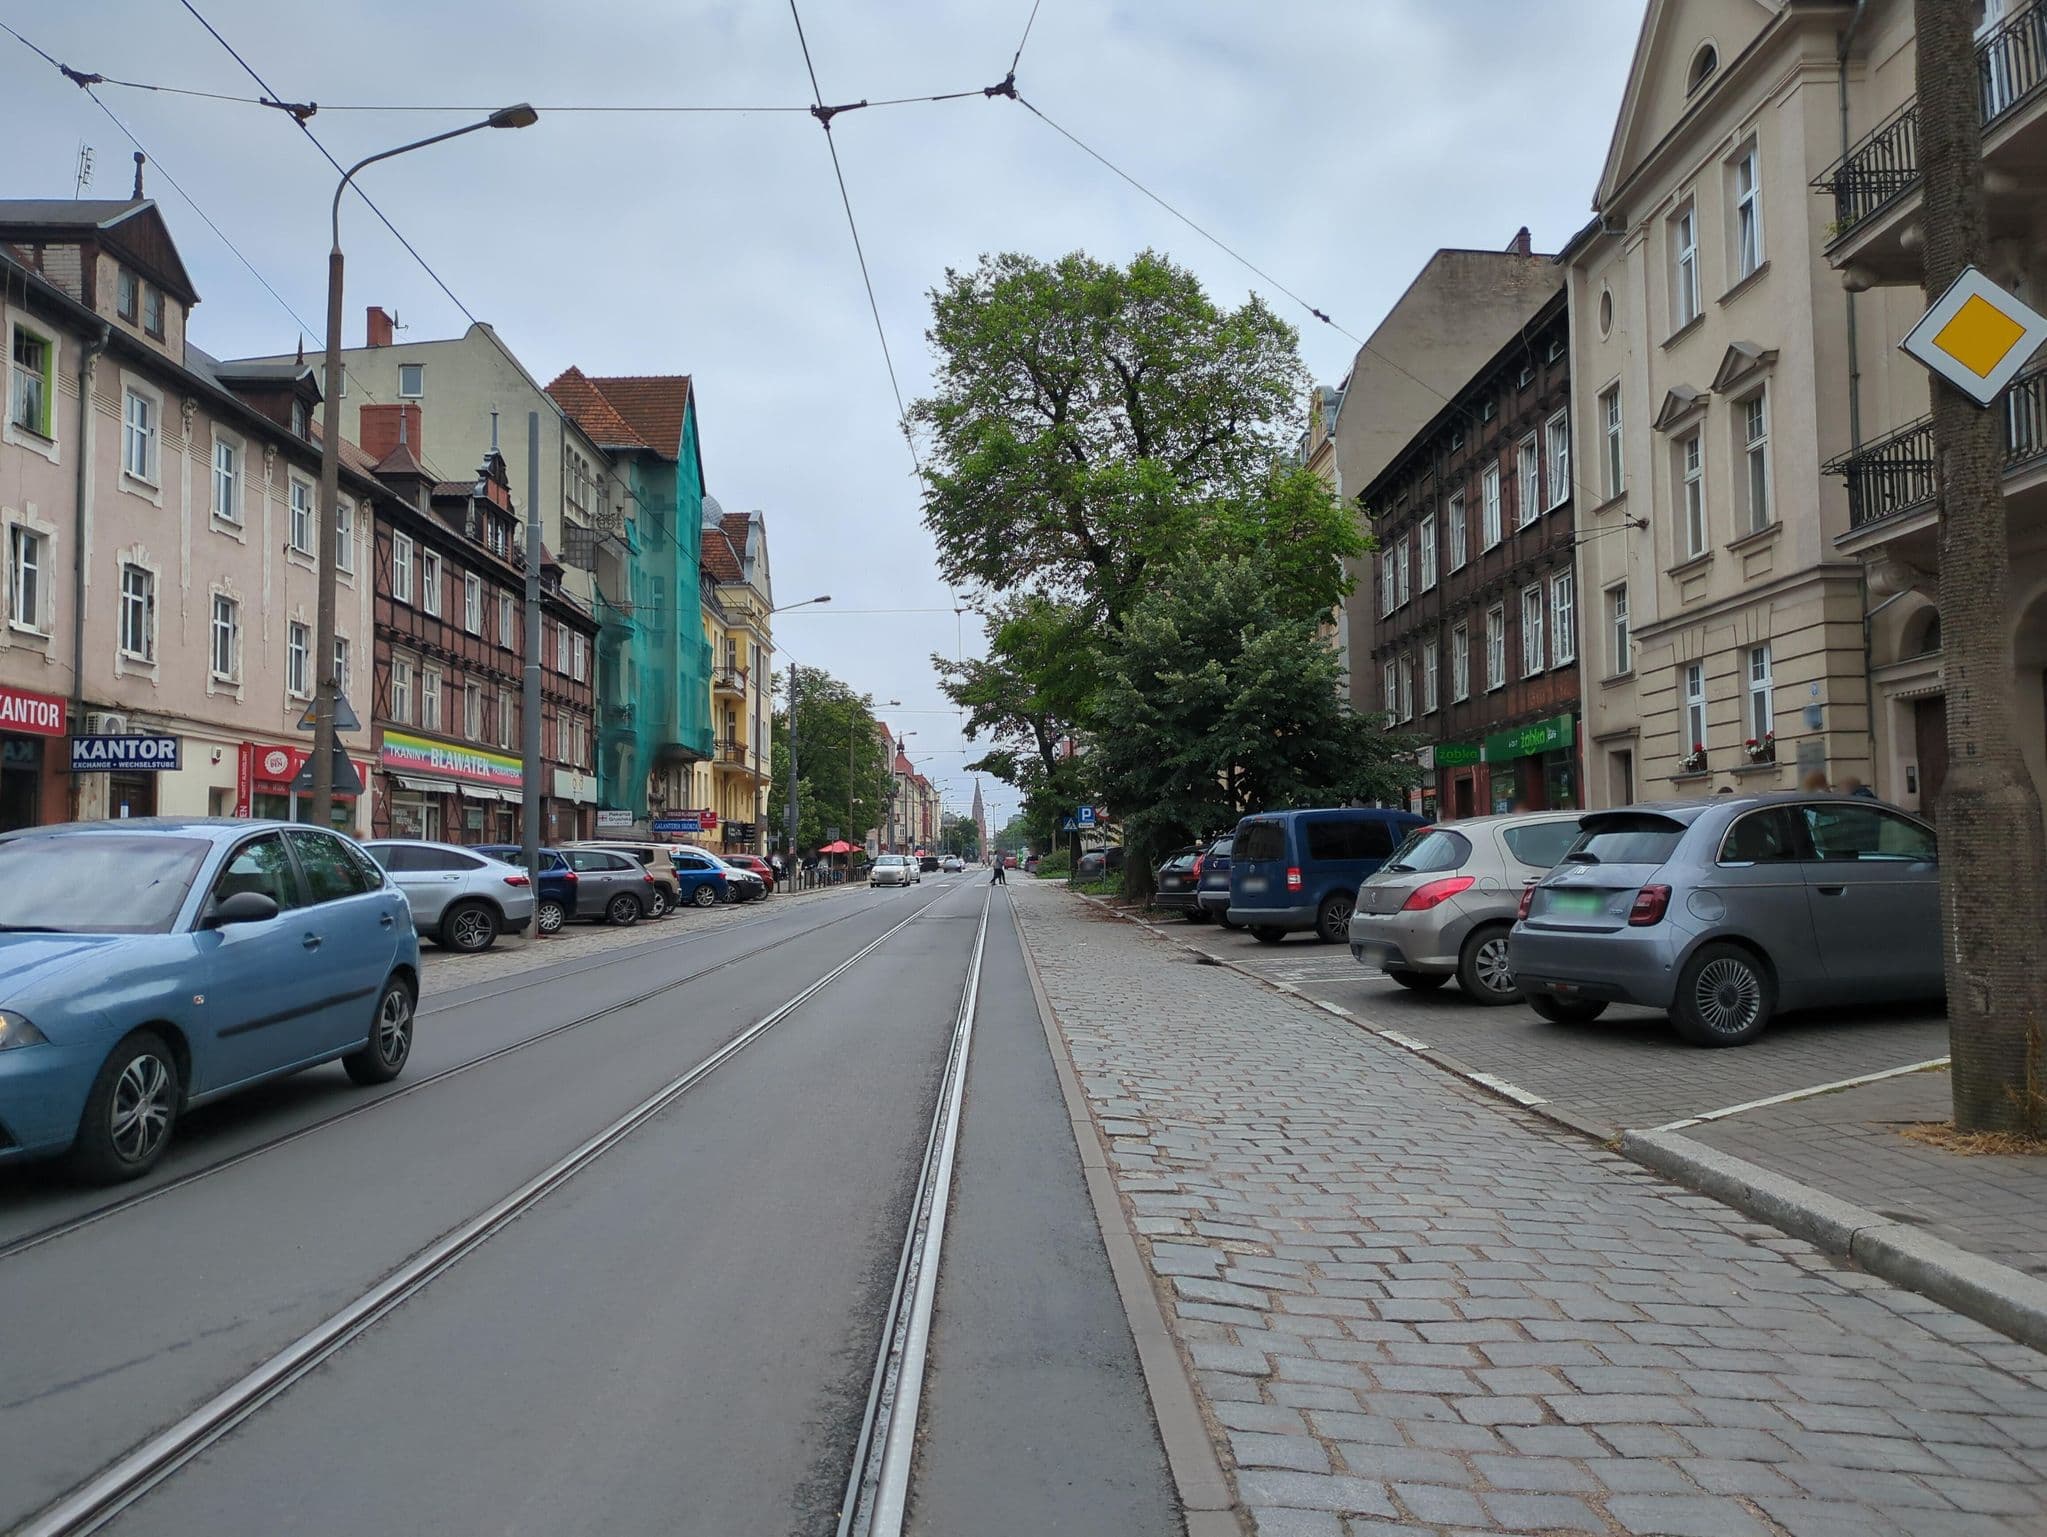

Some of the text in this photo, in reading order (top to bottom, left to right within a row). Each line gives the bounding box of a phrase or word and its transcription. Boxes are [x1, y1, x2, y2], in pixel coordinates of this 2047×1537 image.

[0, 695, 59, 728] ANTOR
[73, 740, 175, 760] KANTOR
[389, 745, 426, 762] TKANINY
[1082, 808, 1092, 821] P
